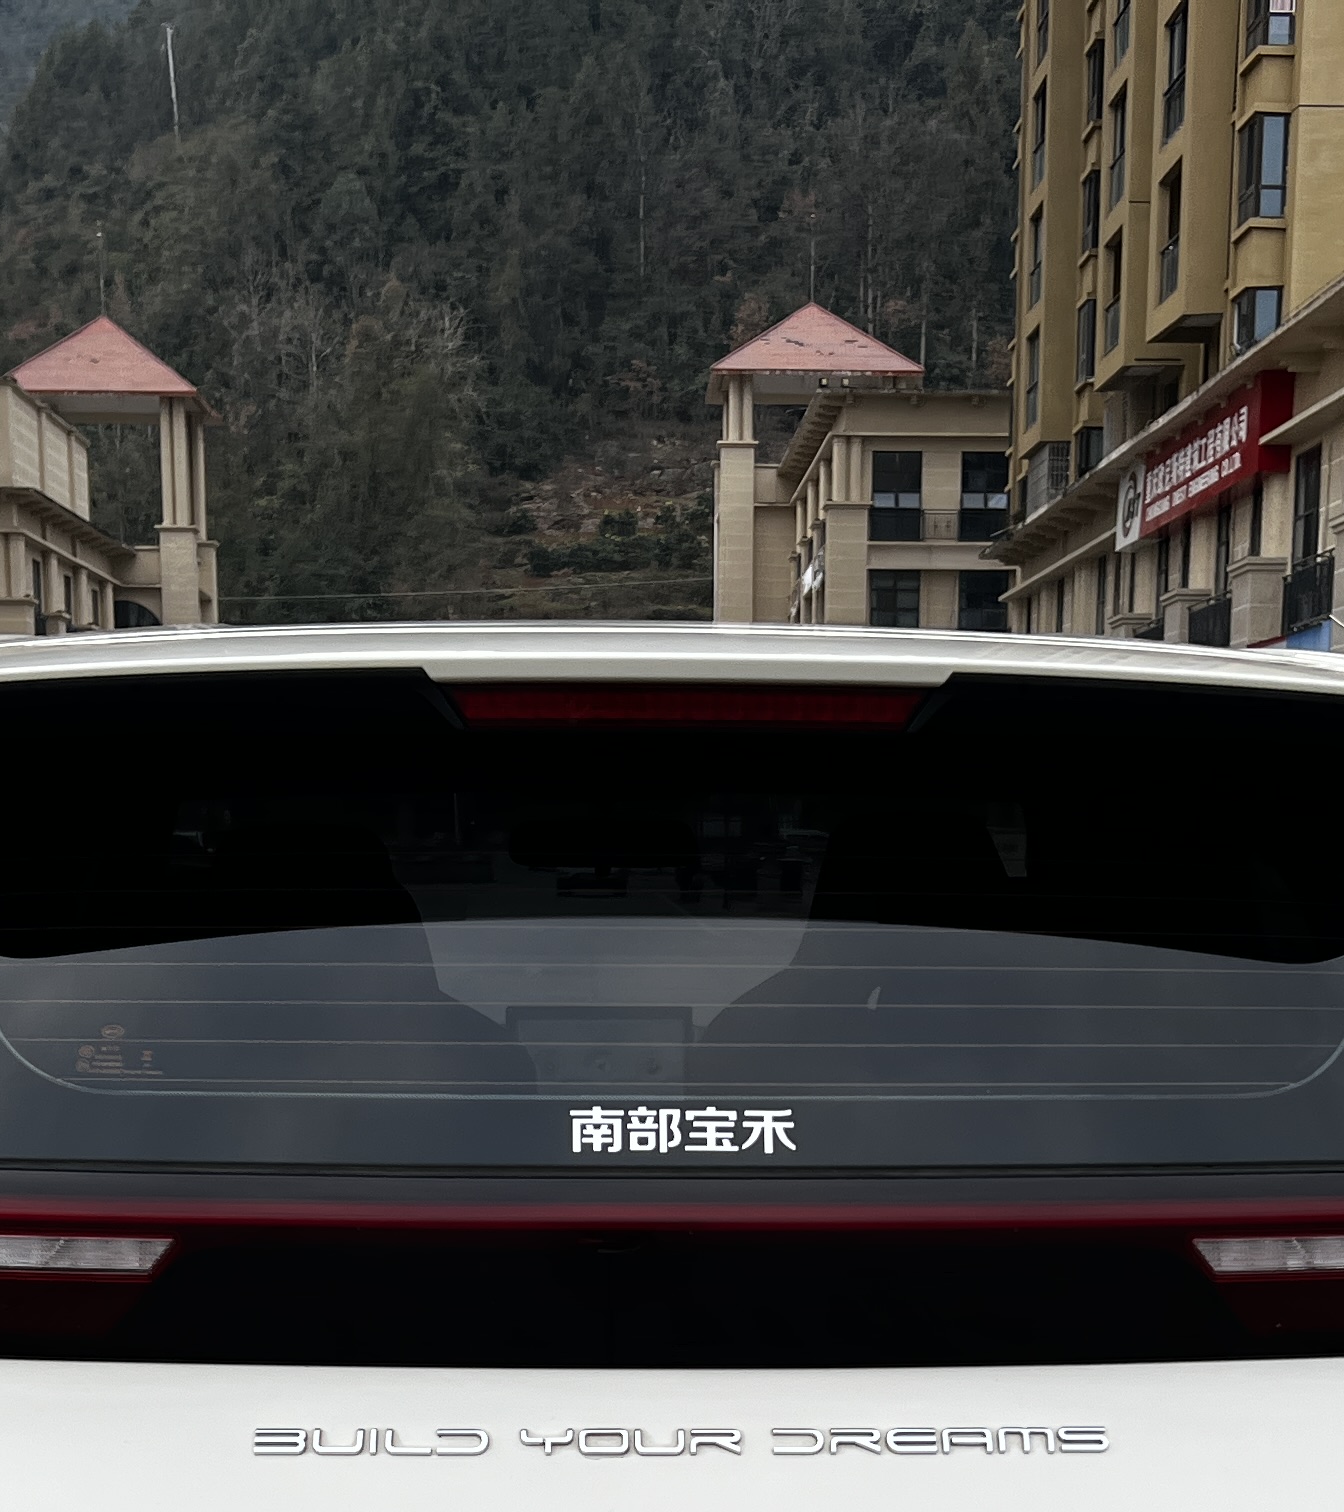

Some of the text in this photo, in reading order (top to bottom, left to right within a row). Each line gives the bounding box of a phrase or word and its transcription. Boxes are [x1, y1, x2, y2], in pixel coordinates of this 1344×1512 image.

[569, 1106, 797, 1154] 南部宝禾
[252, 1424, 1111, 1458] BUILD YOUR DREAMS
